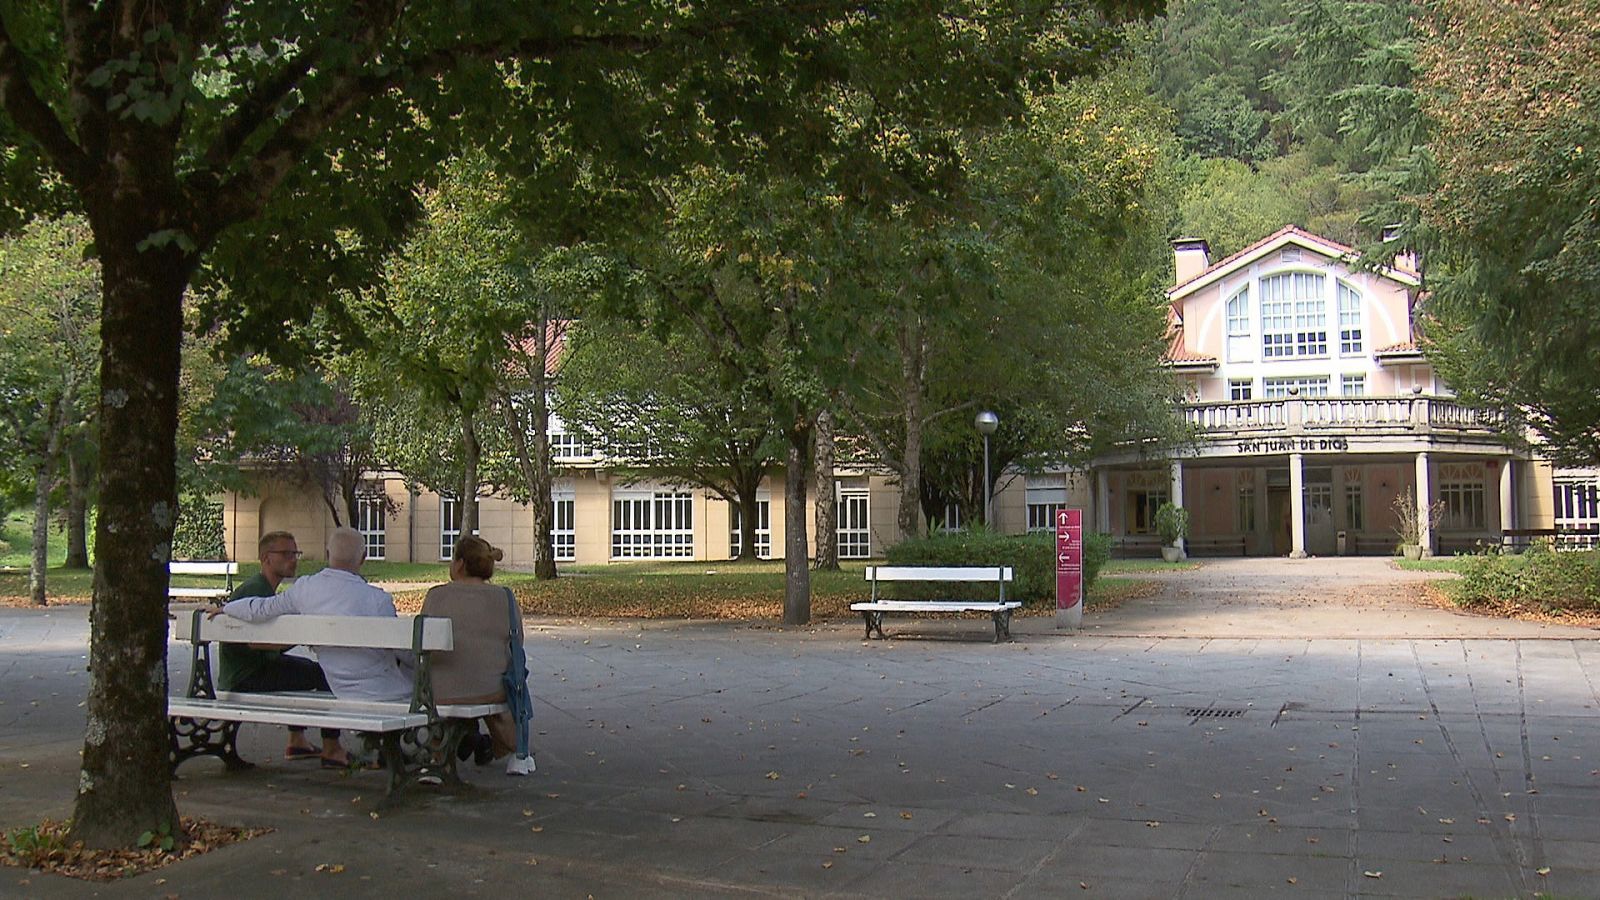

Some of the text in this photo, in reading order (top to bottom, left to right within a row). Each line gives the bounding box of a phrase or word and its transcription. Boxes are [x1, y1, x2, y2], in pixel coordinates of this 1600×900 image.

[1237, 439, 1349, 453] SAN JUAN DE DIOS
